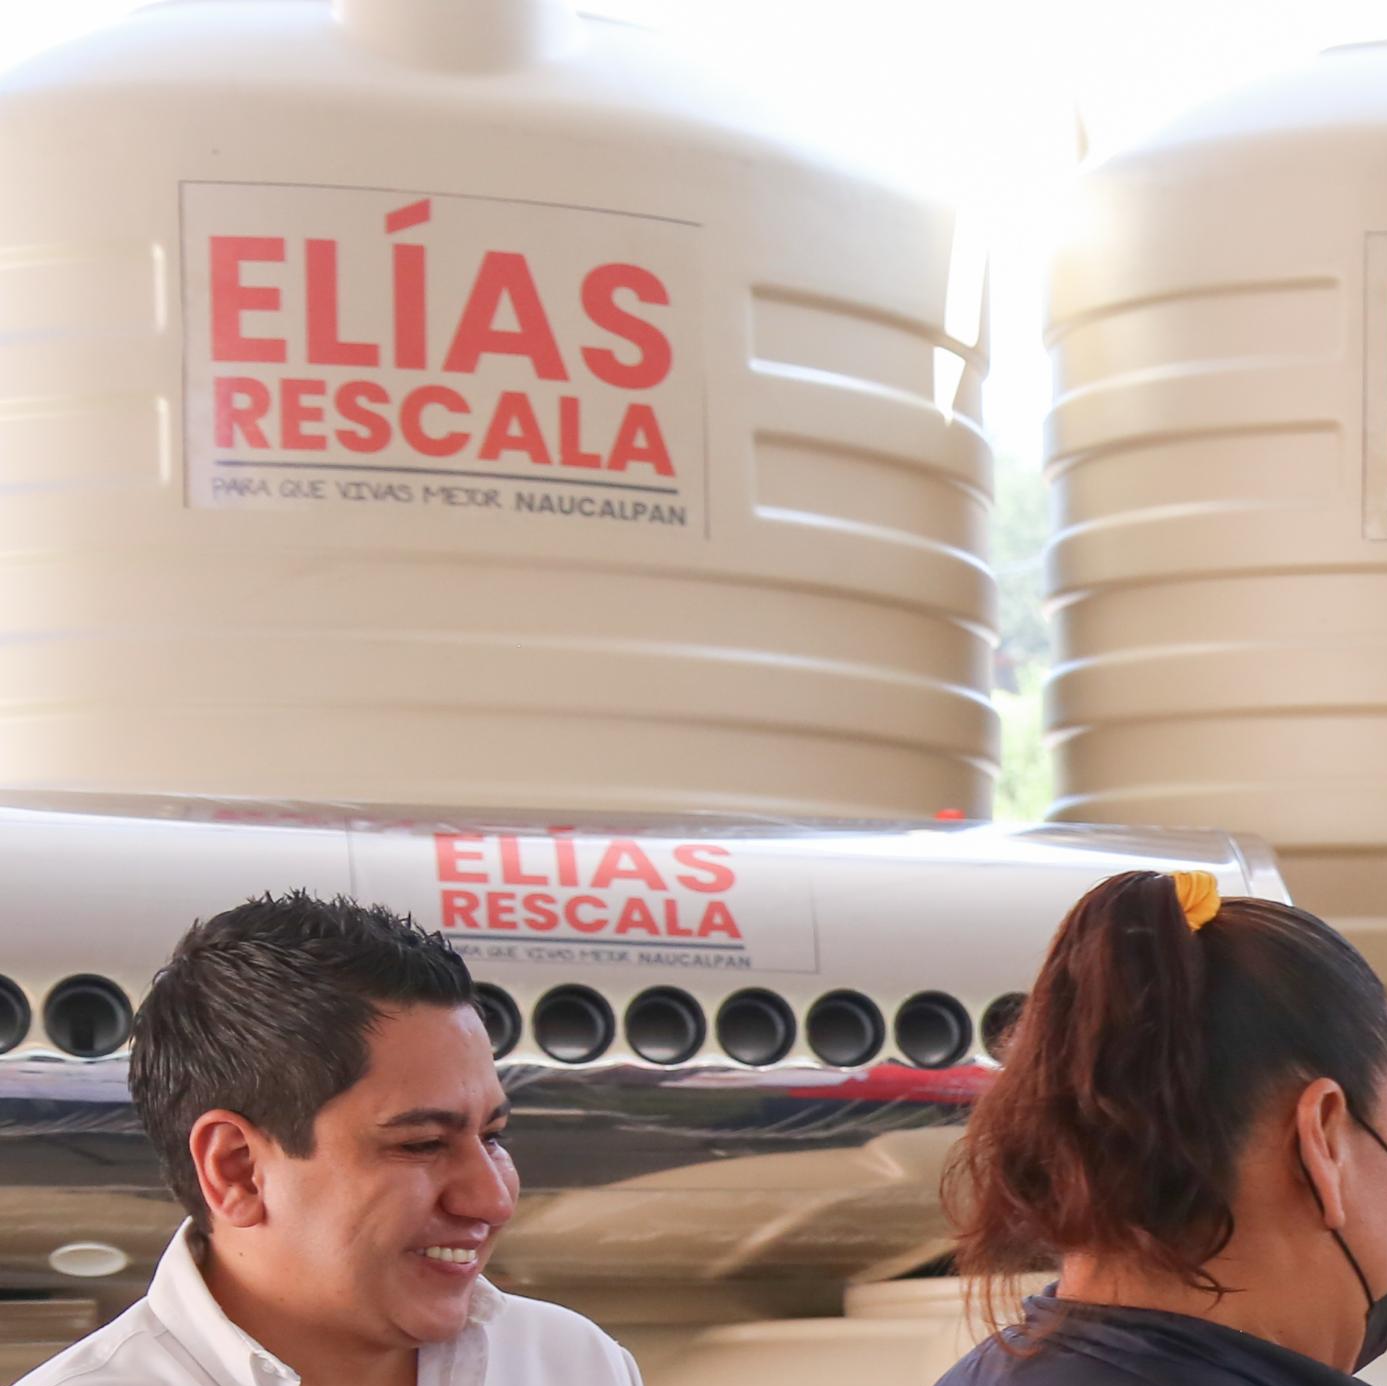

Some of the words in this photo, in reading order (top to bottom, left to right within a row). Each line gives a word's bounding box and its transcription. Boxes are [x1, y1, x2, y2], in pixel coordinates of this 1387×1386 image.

[209, 198, 672, 390] ELÍAS
[213, 377, 676, 477] RESCALA
[212, 477, 271, 499] PARA
[280, 479, 326, 499] QUE
[335, 482, 413, 503] VIVAS
[423, 487, 501, 509] MEJOR
[515, 492, 686, 526] NAUCALPAN
[440, 889, 742, 939] RESCALA
[639, 953, 751, 969] NAUCALPAN
